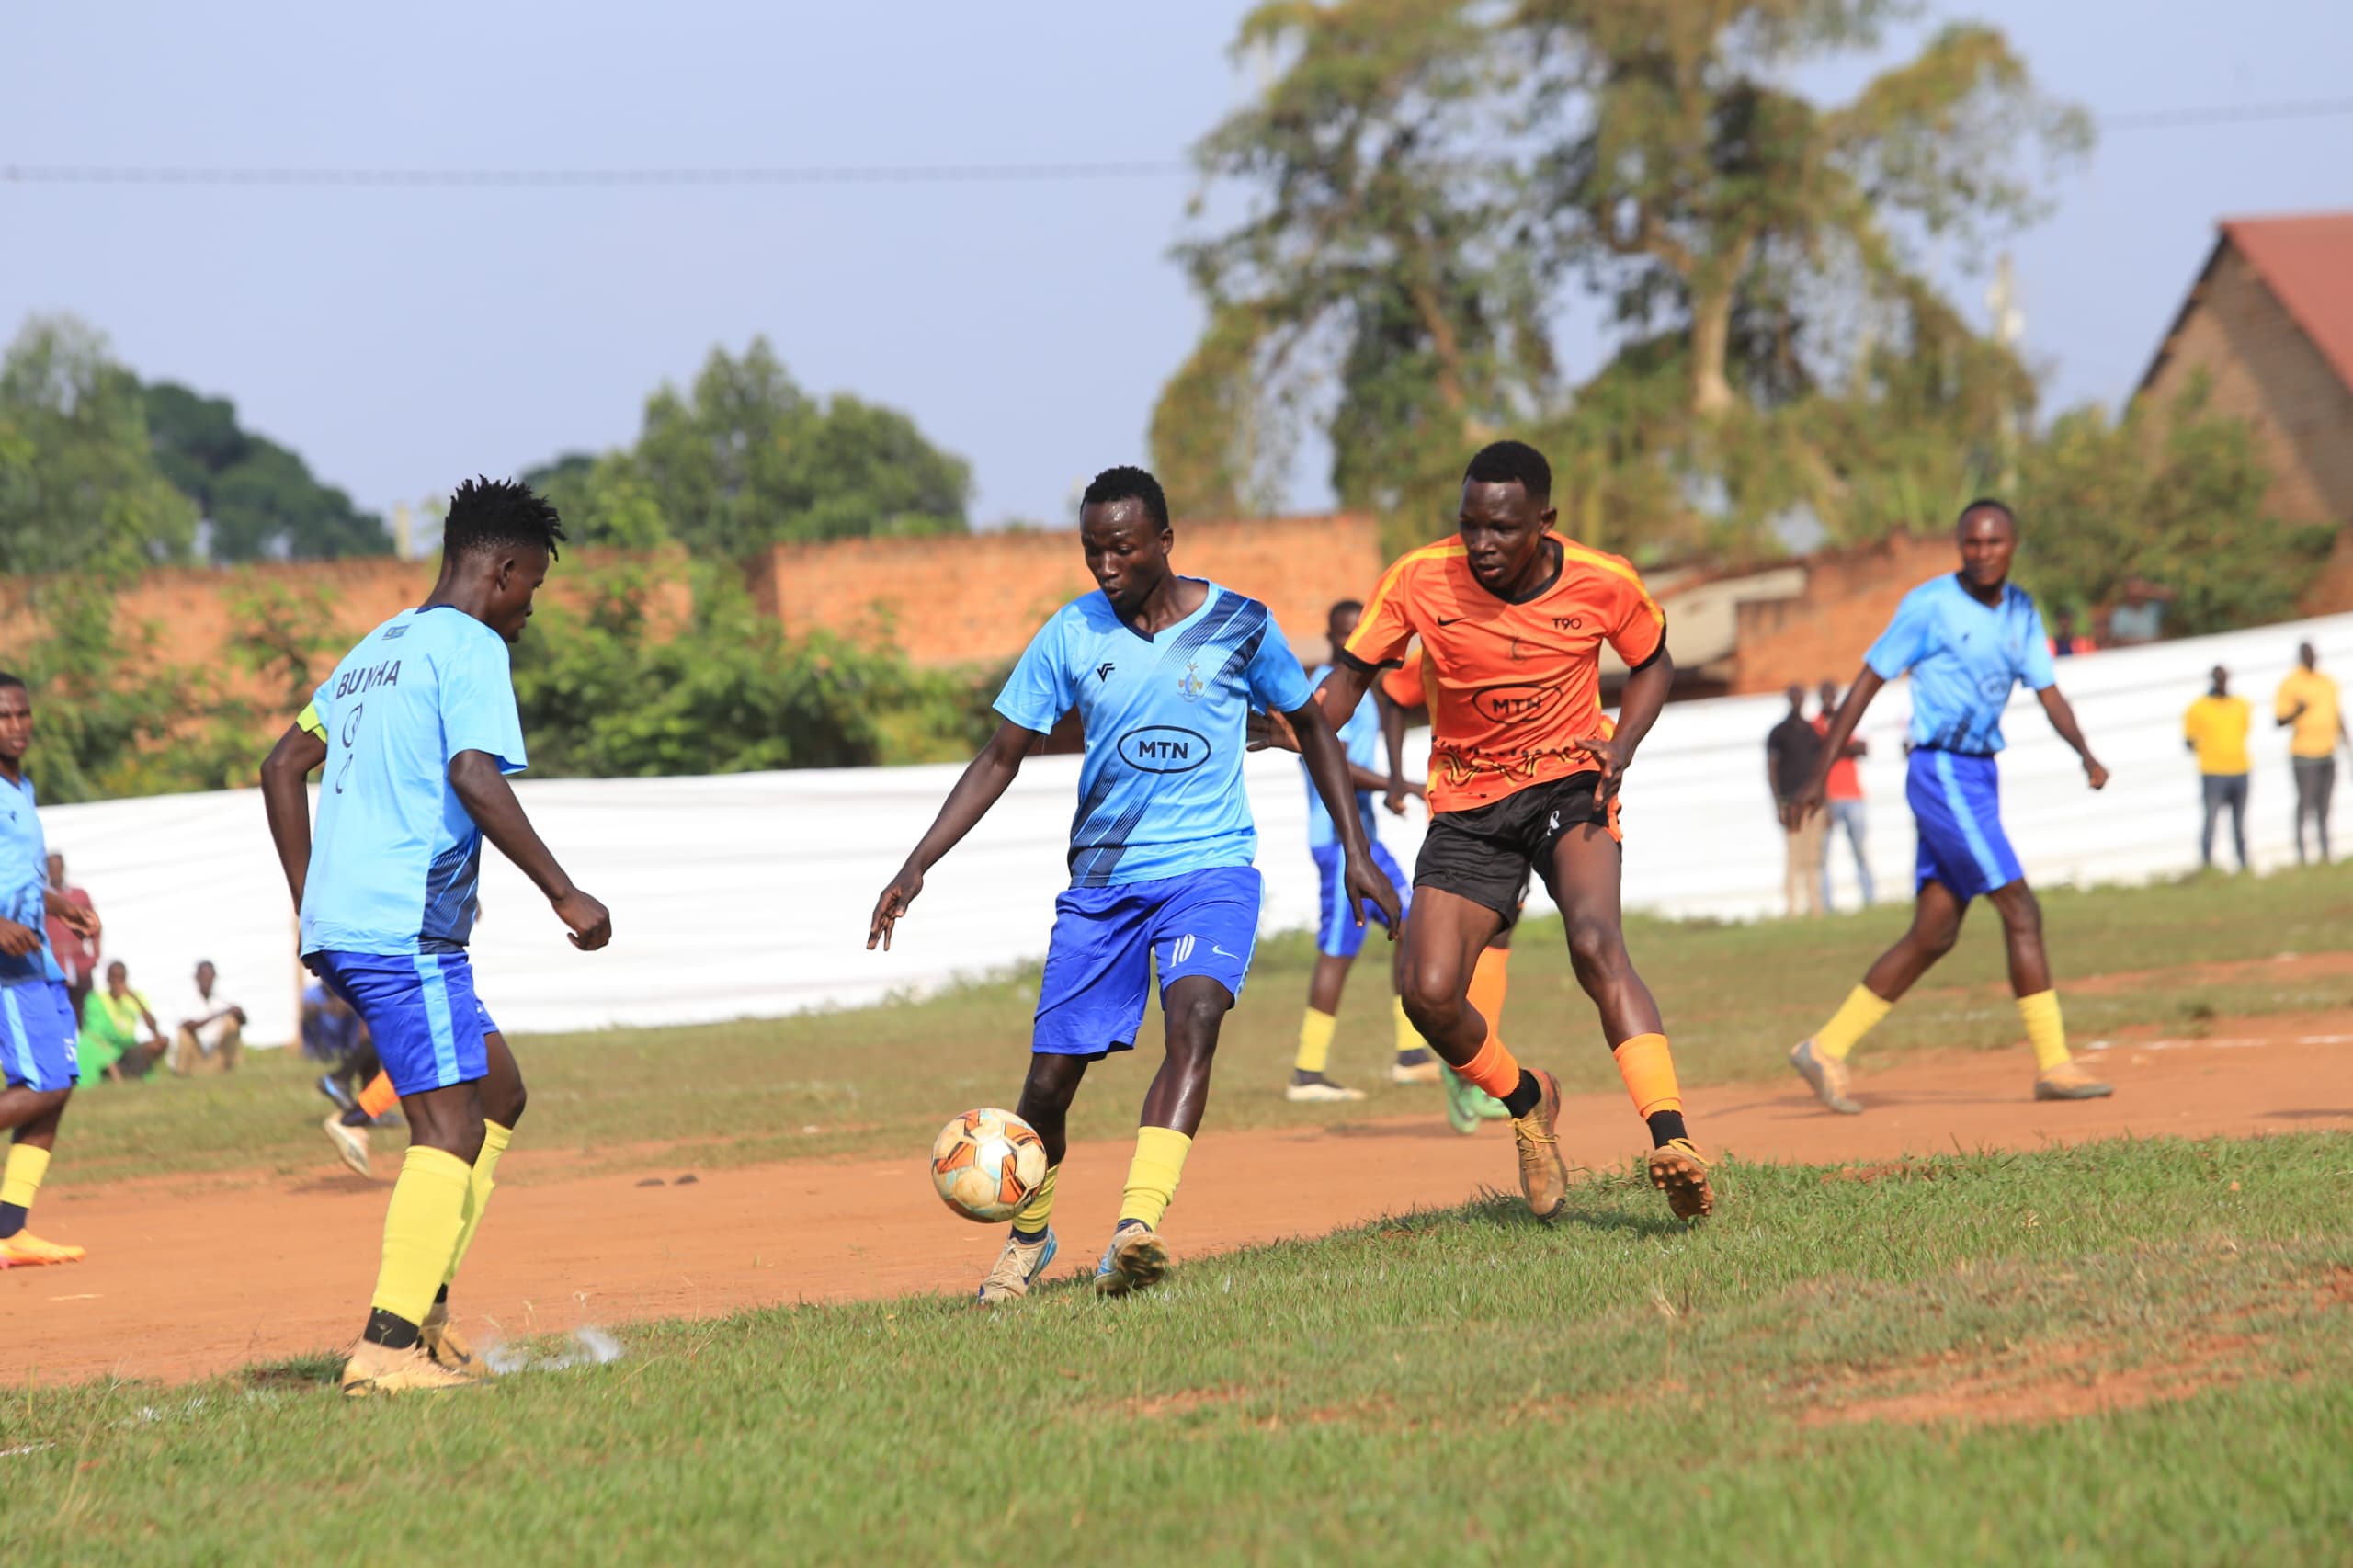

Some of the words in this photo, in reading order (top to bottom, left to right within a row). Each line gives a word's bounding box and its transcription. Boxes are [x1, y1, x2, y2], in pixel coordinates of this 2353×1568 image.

[1552, 618, 1582, 630] T90
[1139, 741, 1188, 759] MTN
[1169, 934, 1195, 968] 10
